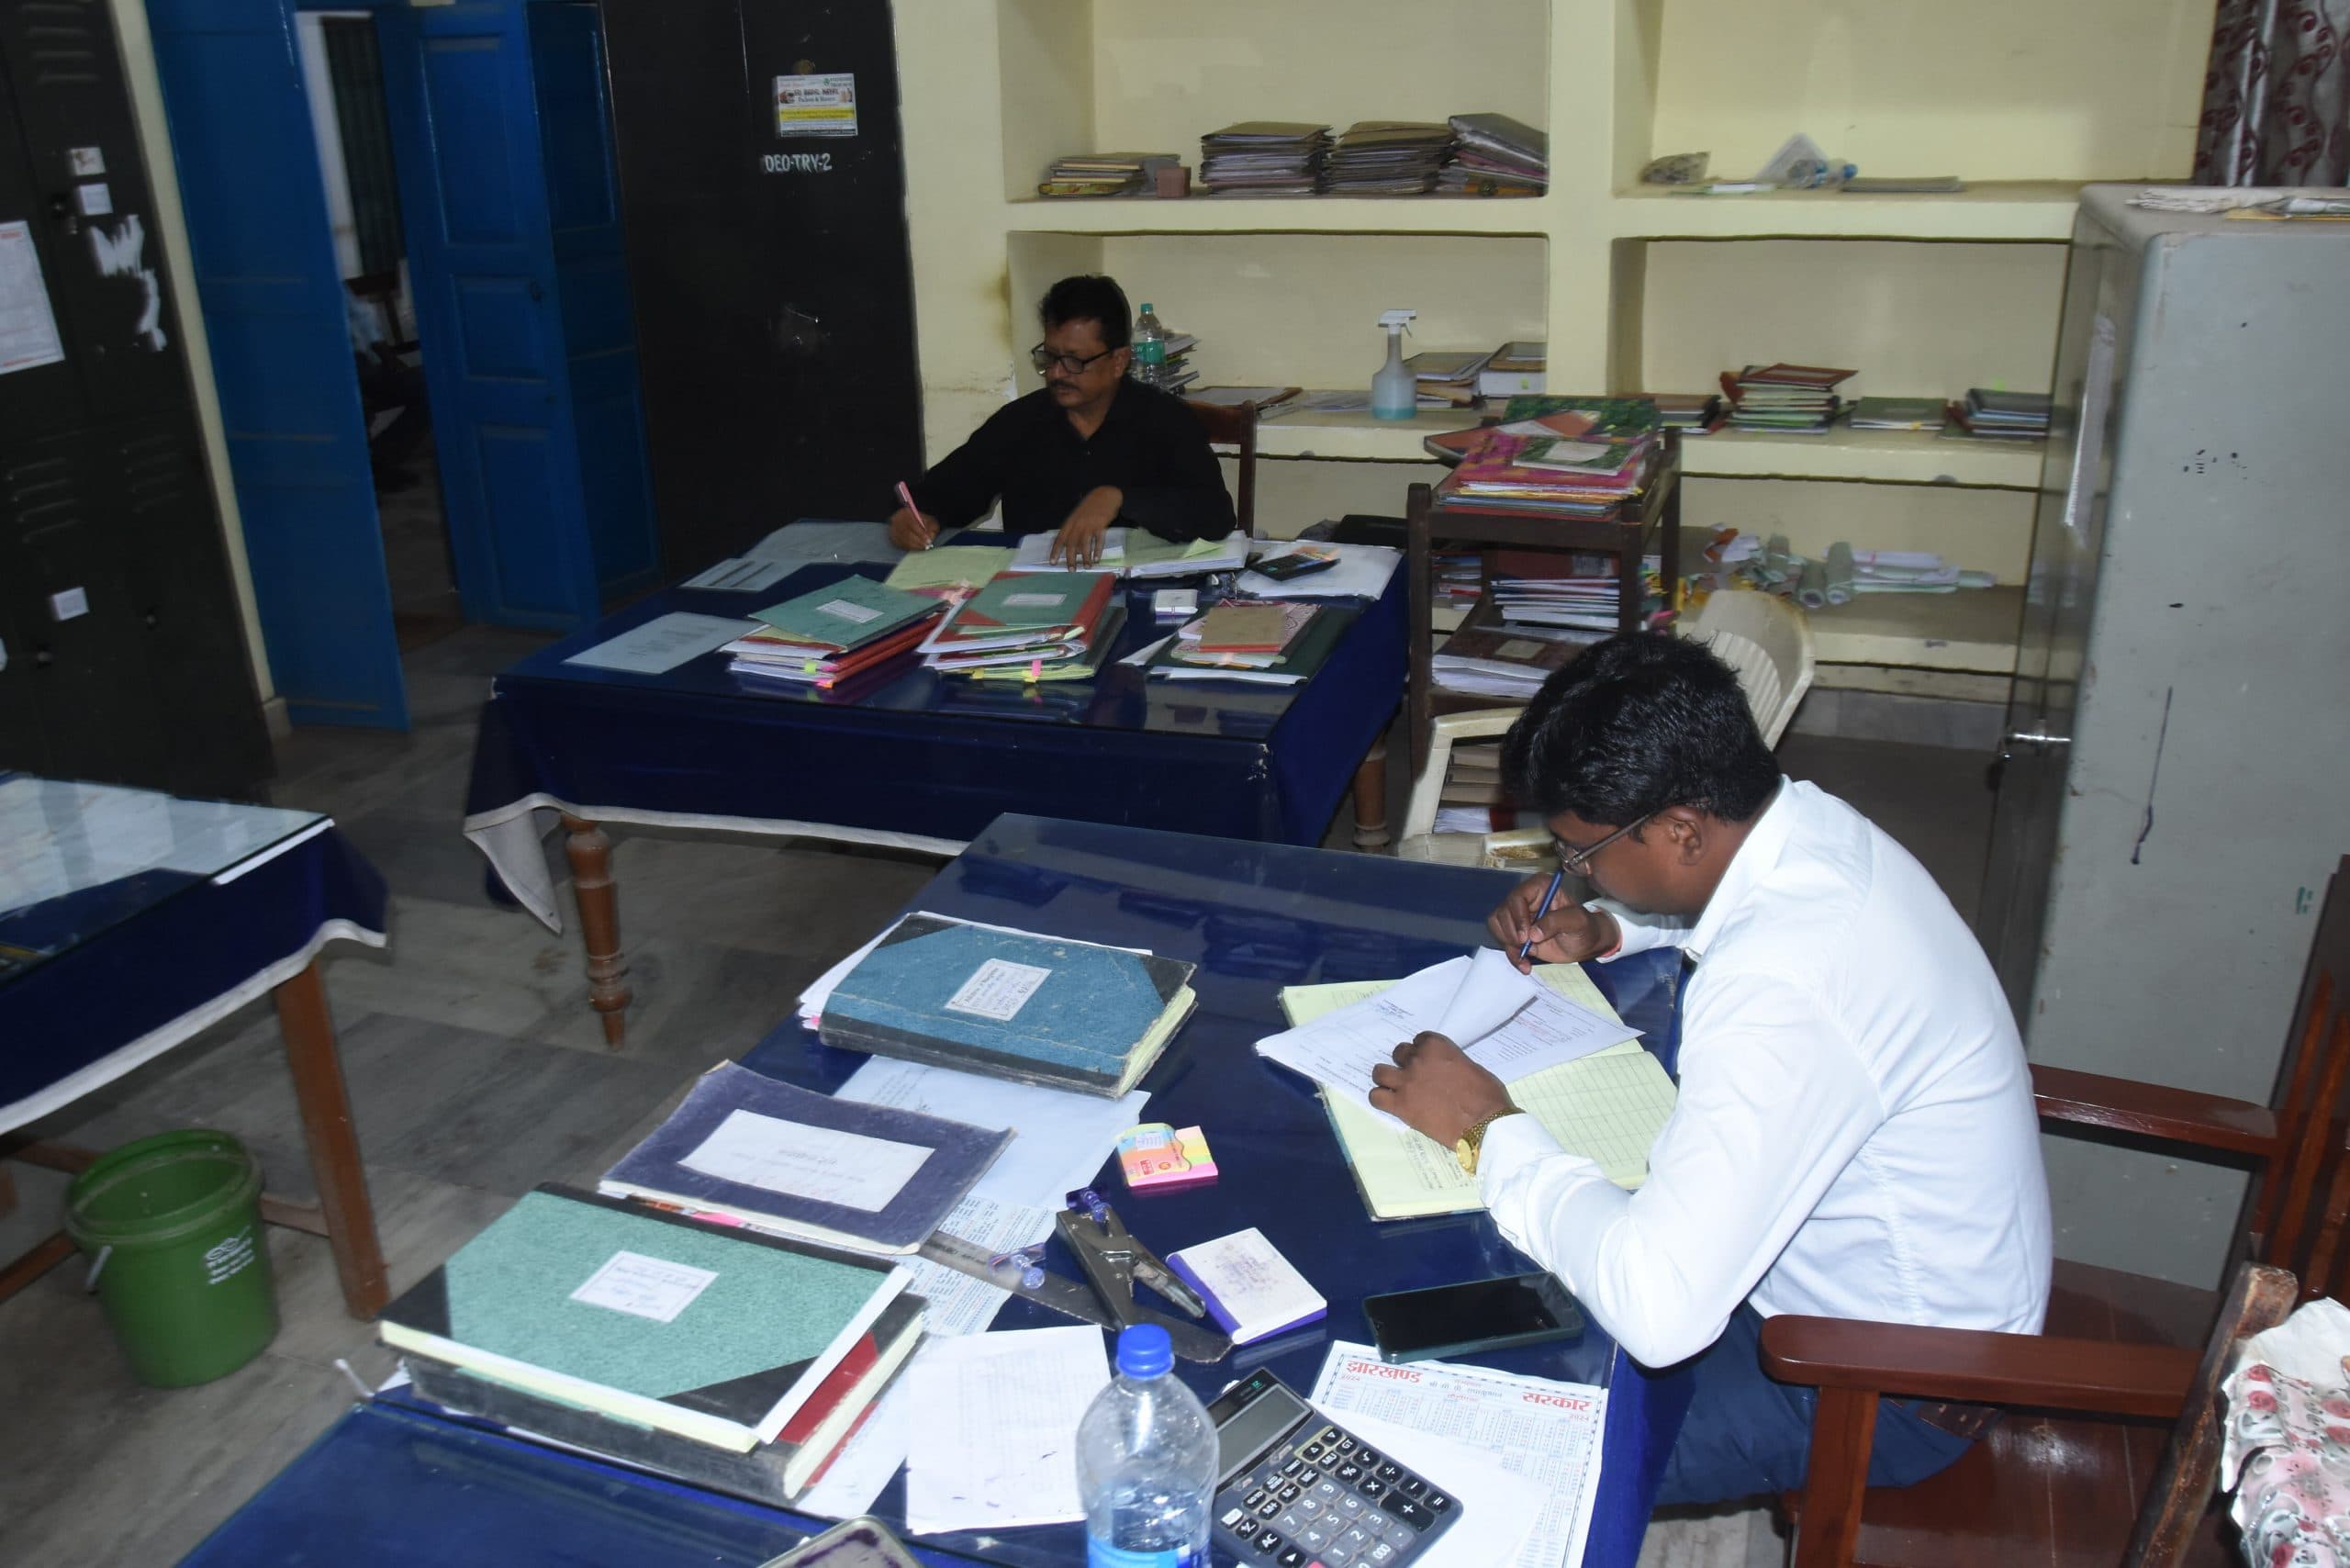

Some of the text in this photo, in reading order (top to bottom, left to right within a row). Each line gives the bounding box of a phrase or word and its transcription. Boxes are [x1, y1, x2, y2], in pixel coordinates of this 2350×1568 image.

[1347, 1361, 1593, 1411] झारखण्ड सरकार
[1341, 1439, 1353, 1449] GT
[1322, 1452, 1337, 1465] MU
[1322, 1484, 1335, 1494] 9
[1304, 1499, 1316, 1508] 8
[1345, 1498, 1358, 1508] 6
[1283, 1515, 1295, 1526] 7
[1326, 1514, 1339, 1524] 5
[1369, 1514, 1382, 1524] 3
[1308, 1531, 1321, 1541] 4
[1350, 1529, 1365, 1540] 2
[1261, 1533, 1278, 1548] AC
[1333, 1547, 1345, 1557] 1
[1372, 1543, 1392, 1560] 000
